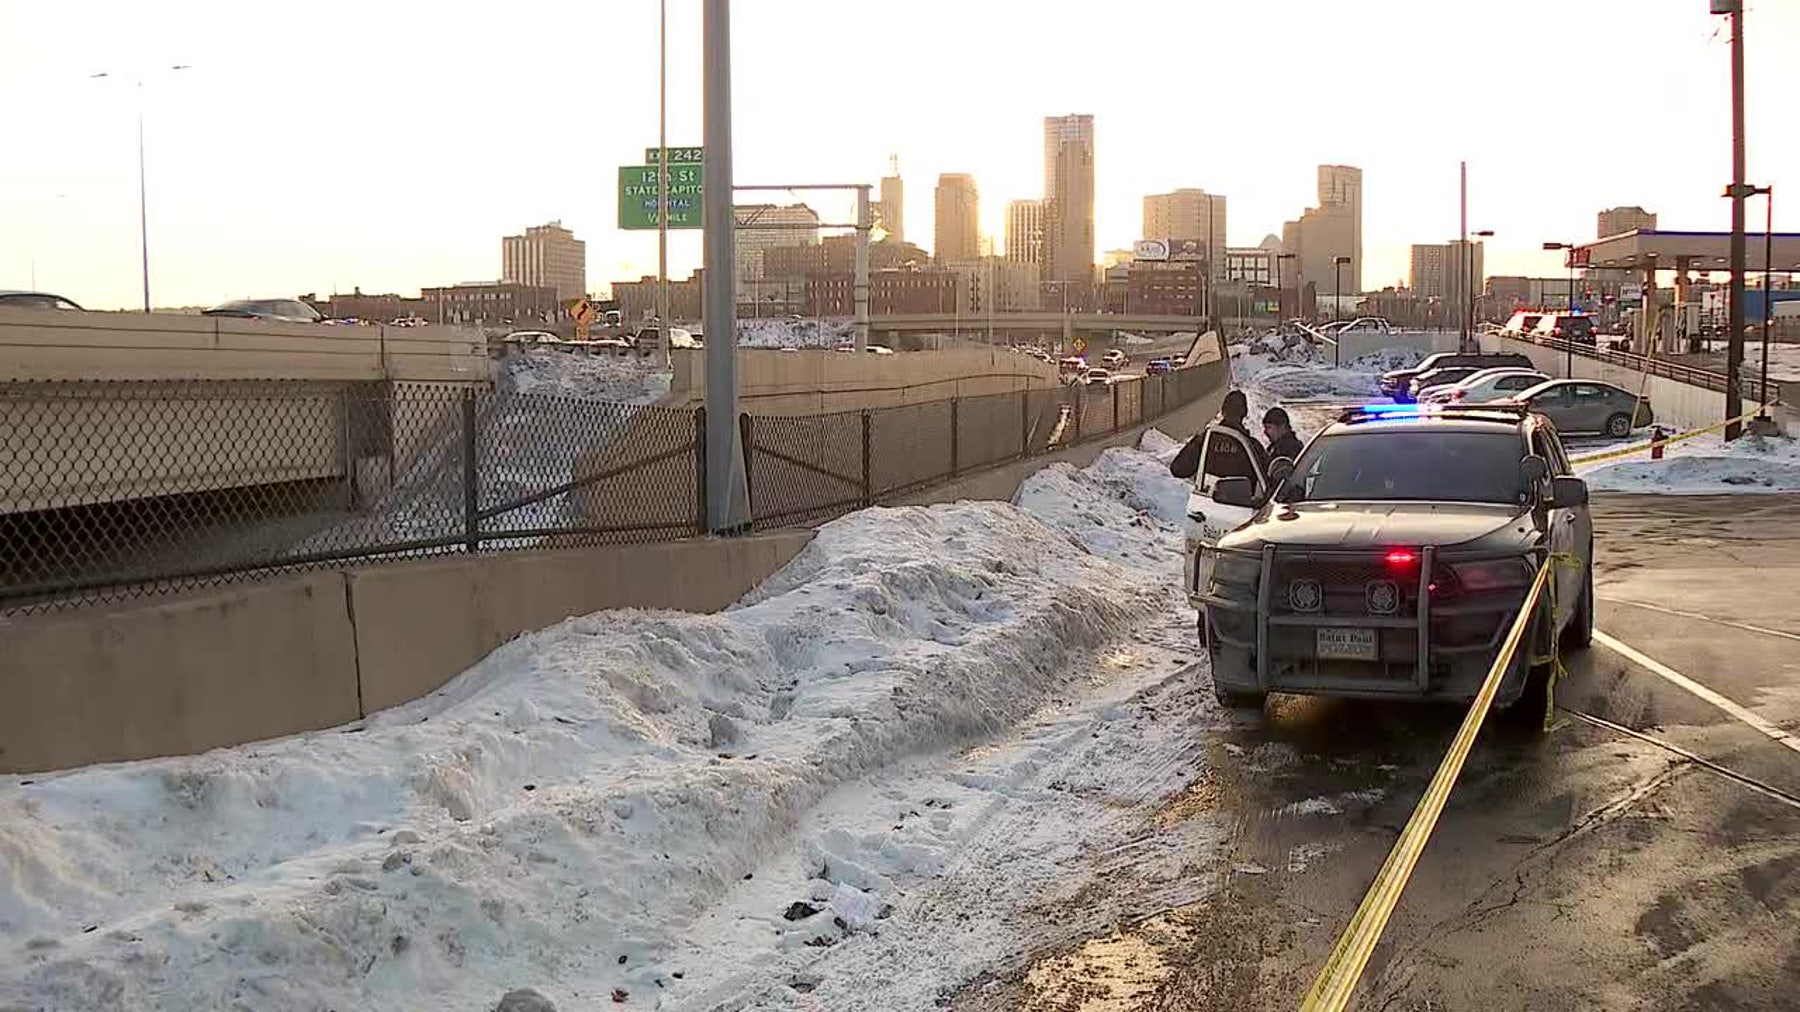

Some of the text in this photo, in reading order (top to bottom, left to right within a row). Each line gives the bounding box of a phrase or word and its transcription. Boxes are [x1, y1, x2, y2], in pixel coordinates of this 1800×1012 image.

[674, 149, 702, 161] 242
[679, 170, 695, 181] St
[625, 187, 658, 195] STATE
[645, 200, 691, 208] HOITAL
[666, 213, 687, 222] MILE
